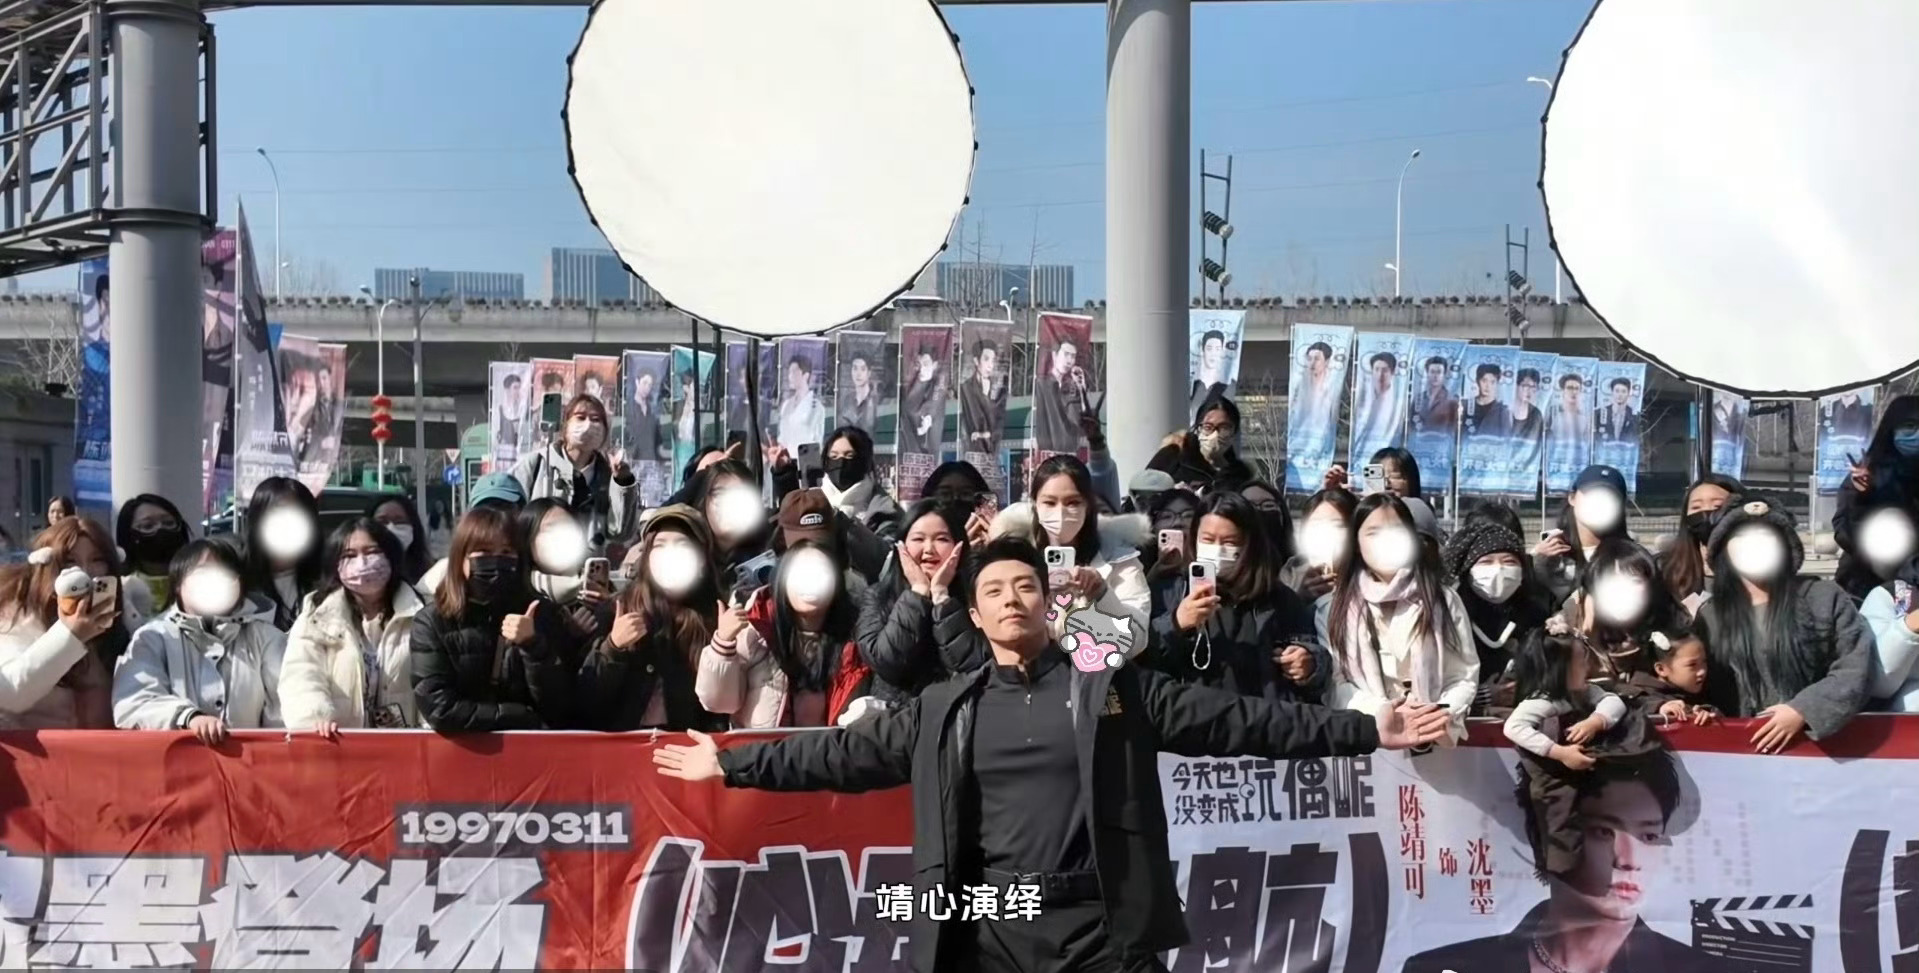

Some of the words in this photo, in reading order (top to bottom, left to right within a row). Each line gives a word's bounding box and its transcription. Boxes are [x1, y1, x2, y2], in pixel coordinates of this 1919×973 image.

[1172, 762, 1239, 790] 今天也
[1238, 757, 1375, 823] 玩偶呢
[402, 811, 629, 843] 19970311
[1172, 793, 1240, 825] 没变成
[1399, 784, 1426, 900] 陈靖可
[1439, 847, 1457, 877] 饰
[1466, 838, 1494, 914] 沈墨
[0, 850, 544, 972] 墨登场
